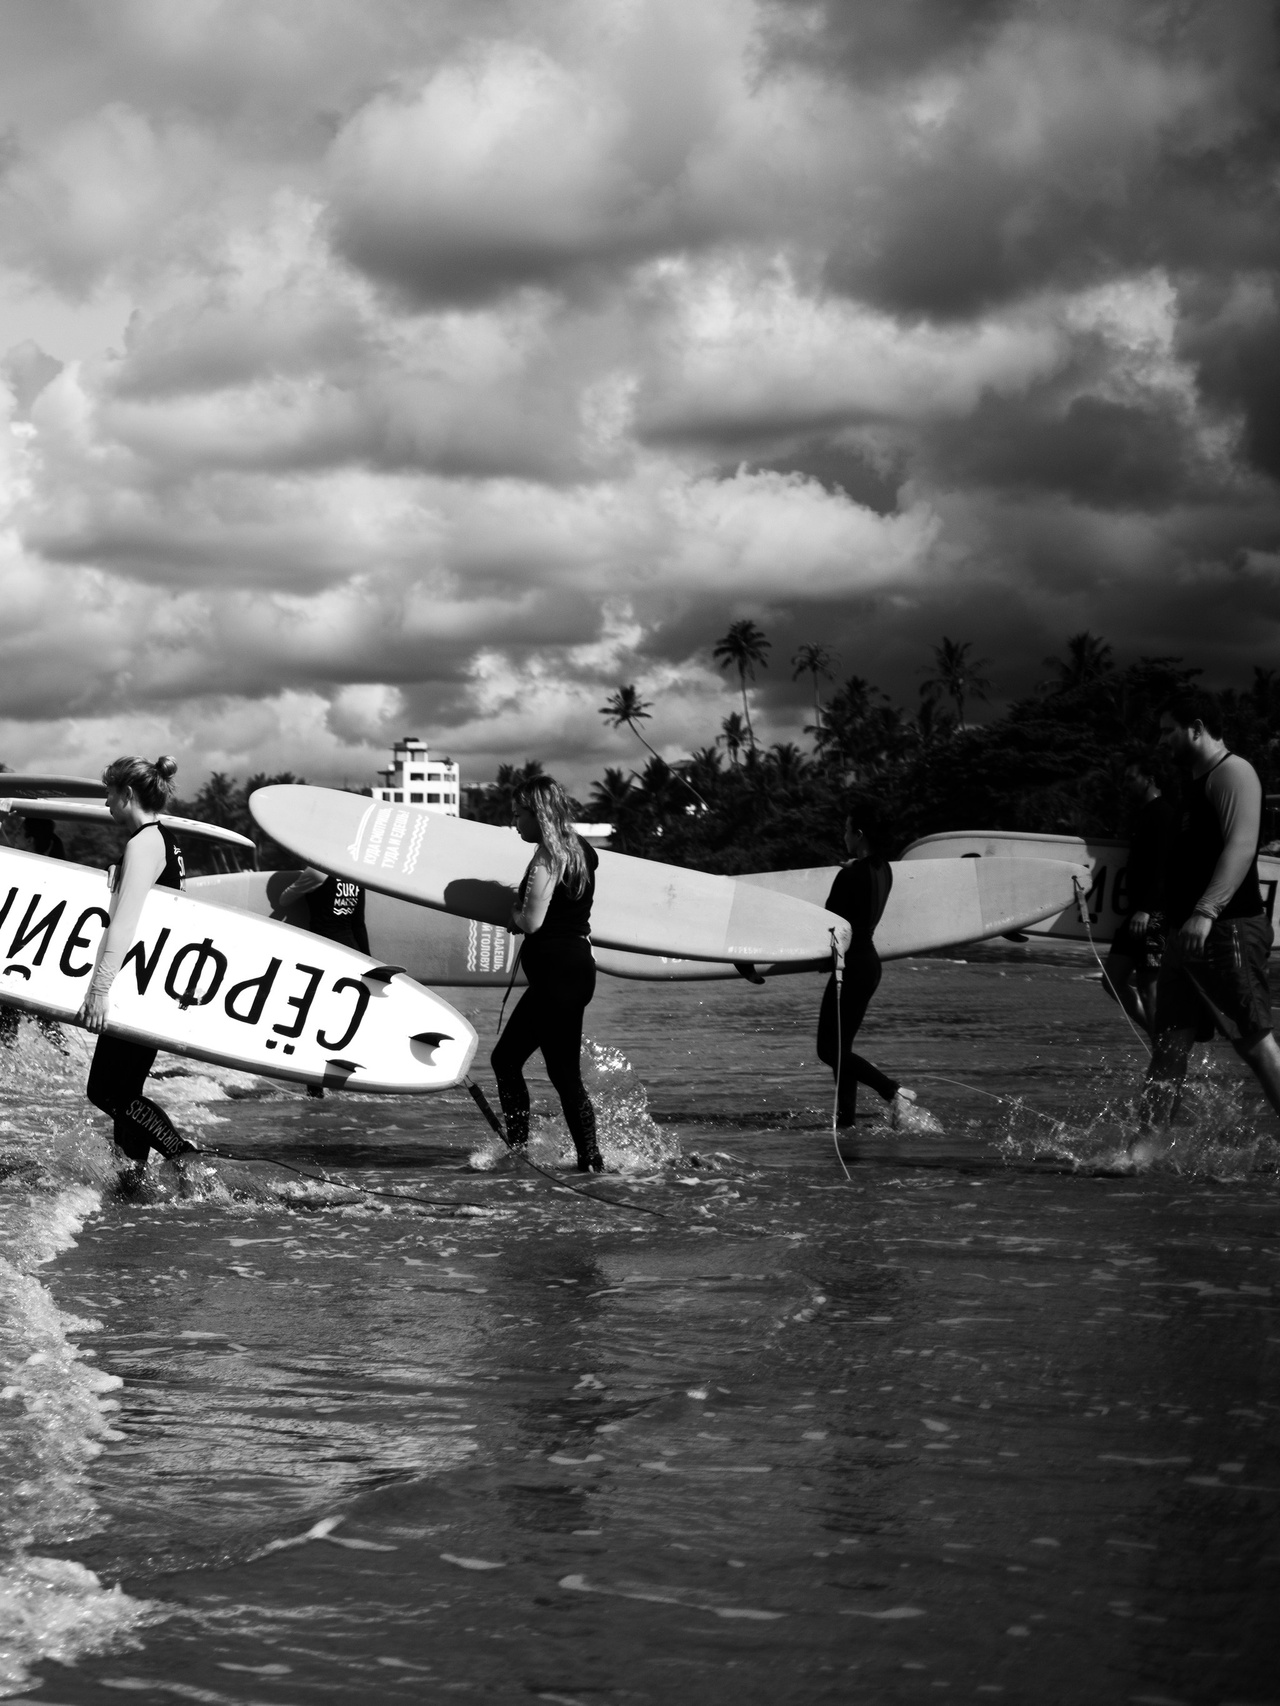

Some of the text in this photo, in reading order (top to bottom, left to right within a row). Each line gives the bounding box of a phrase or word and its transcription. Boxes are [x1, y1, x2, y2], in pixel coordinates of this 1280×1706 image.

[388, 838, 401, 846] И
[363, 844, 381, 865] КУДА
[381, 846, 400, 869] ТУДА
[480, 933, 491, 972] ГОЛОВУ!
[125, 1100, 184, 1154] SURFMAKERS
